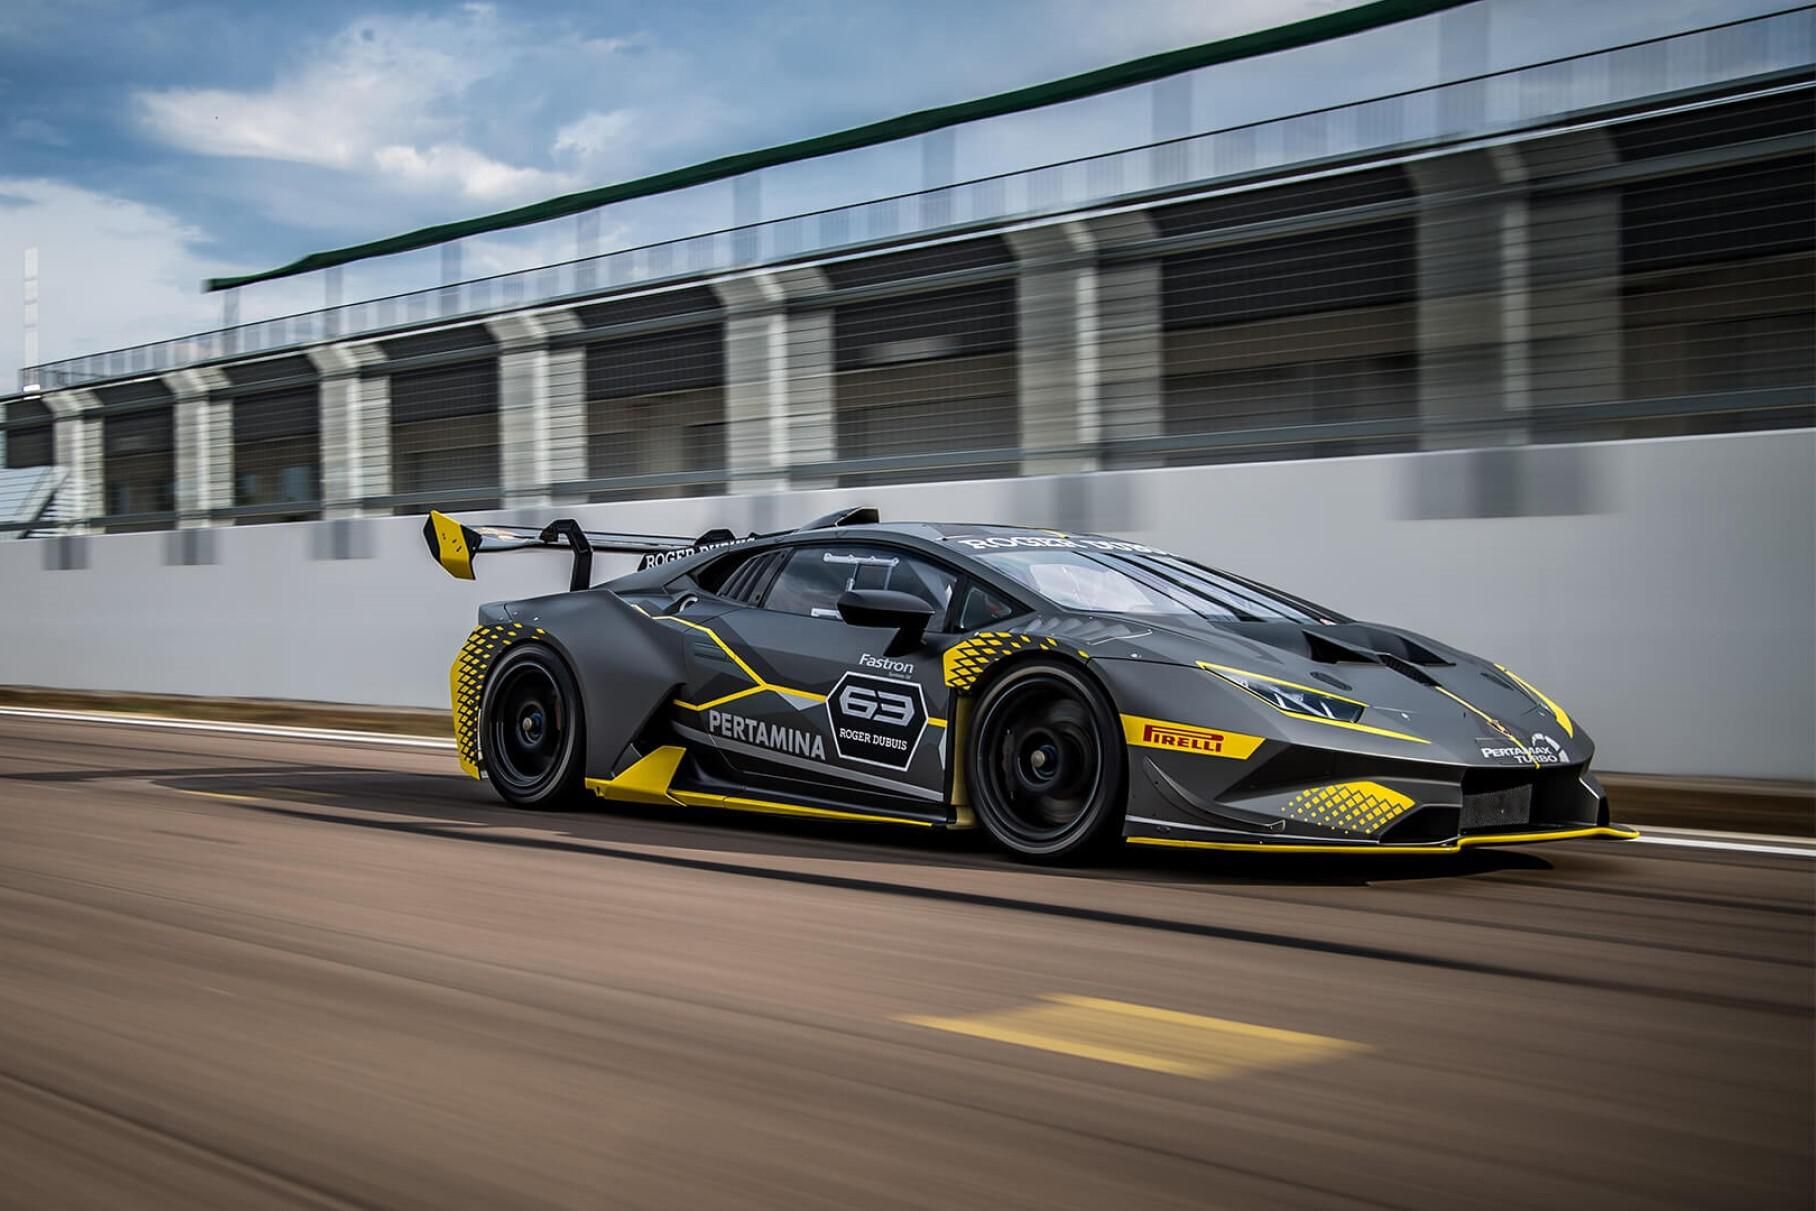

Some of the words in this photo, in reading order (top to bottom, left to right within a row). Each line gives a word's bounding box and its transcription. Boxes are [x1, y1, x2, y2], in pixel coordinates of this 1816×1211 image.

[958, 537, 1088, 549] ROGER
[859, 653, 914, 673] Fastron
[839, 685, 915, 727] 63
[709, 709, 826, 760] PERTAMINA
[840, 728, 871, 743] ROGER
[872, 734, 908, 751] DUBUIS
[1143, 724, 1224, 752] PIRELLI
[1481, 746, 1552, 758] PERTAMAX
[1514, 755, 1558, 764] TURBO
